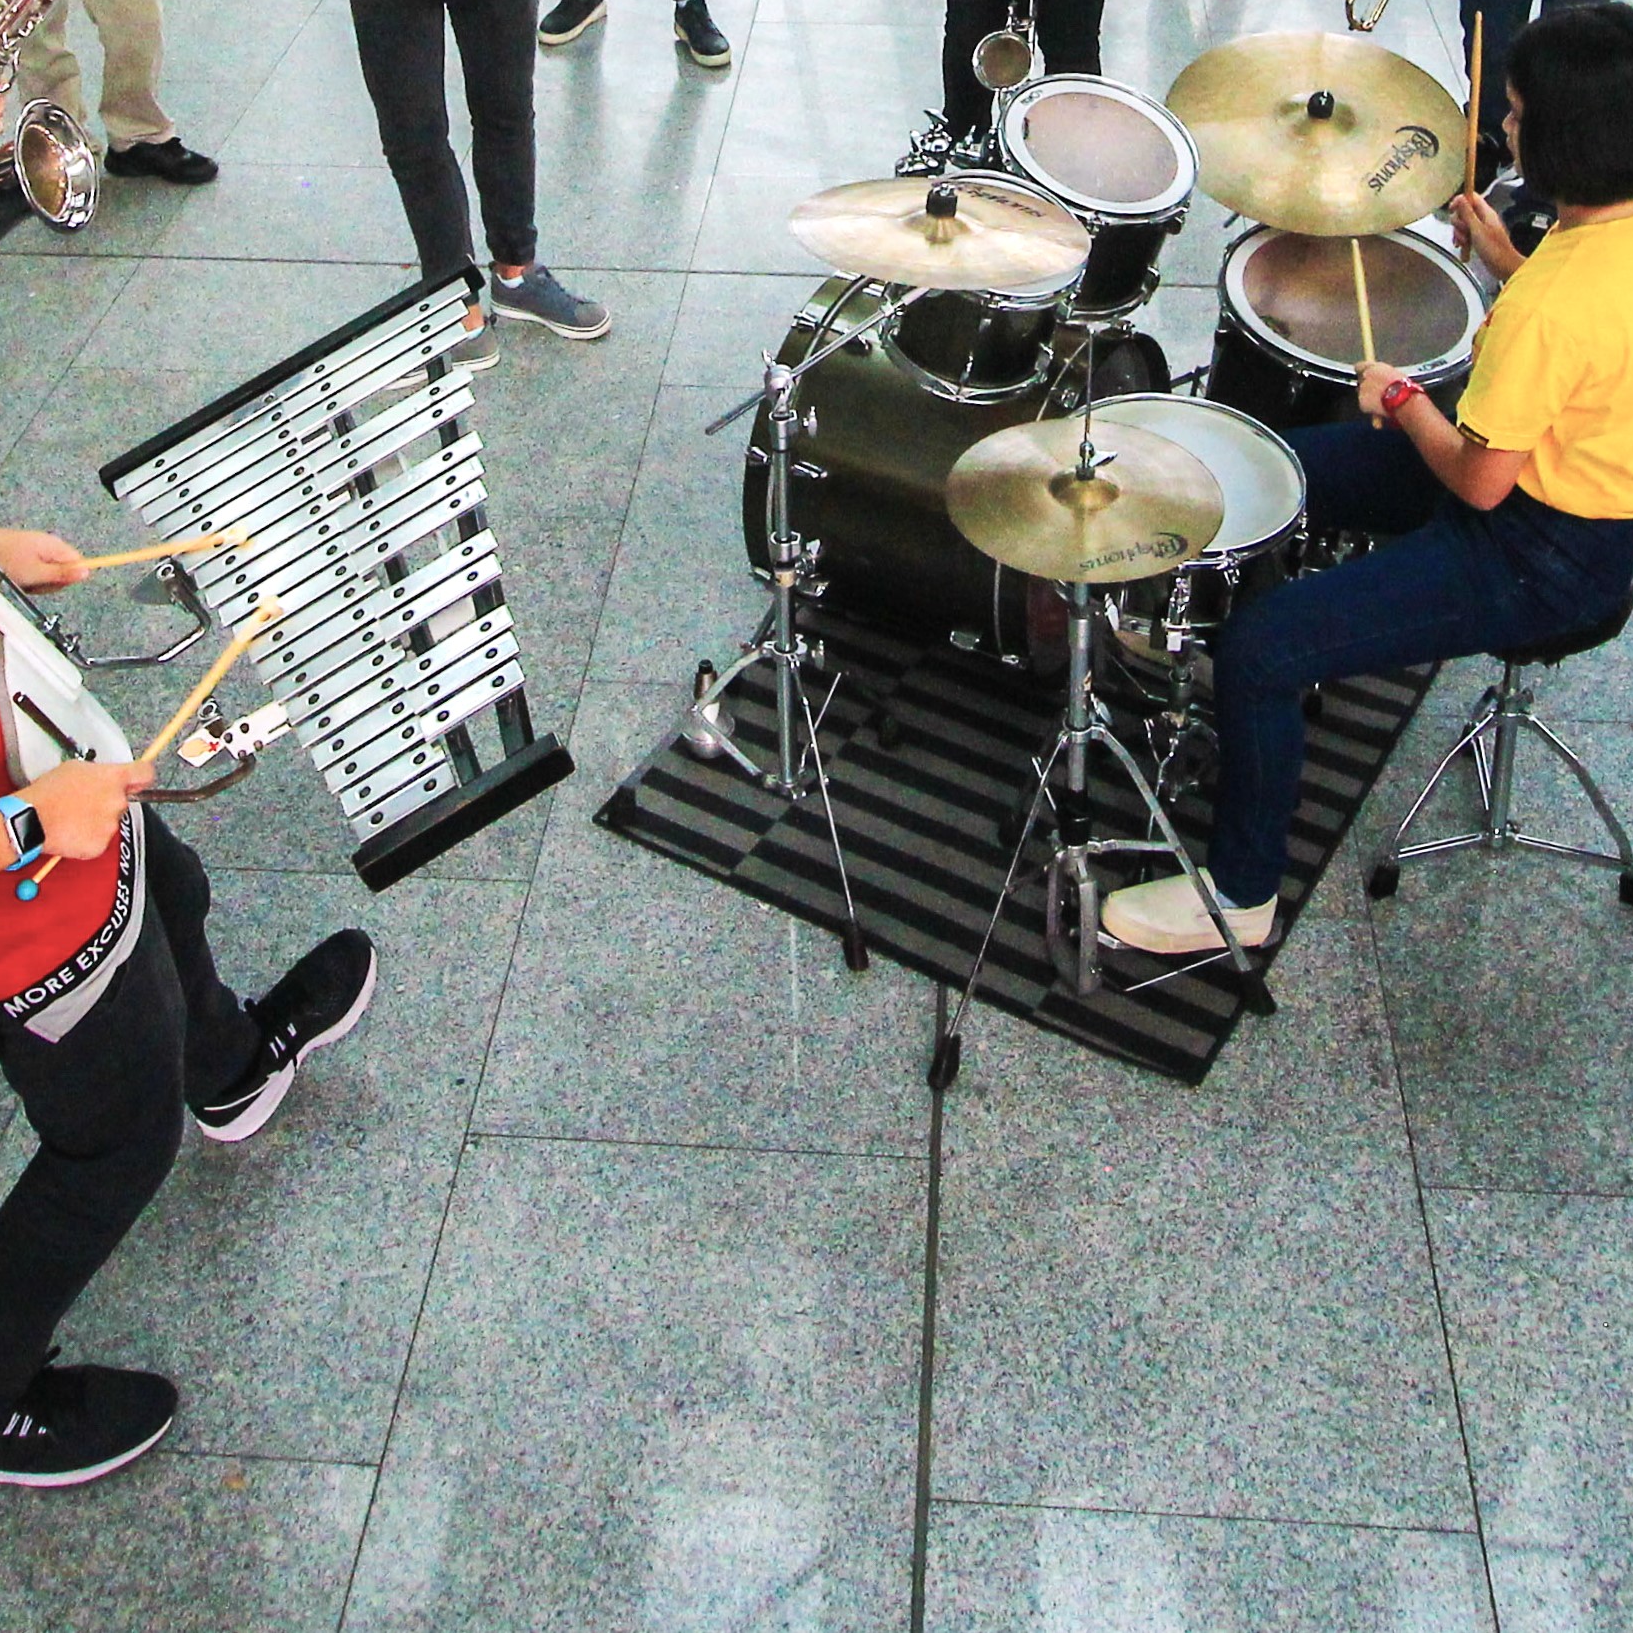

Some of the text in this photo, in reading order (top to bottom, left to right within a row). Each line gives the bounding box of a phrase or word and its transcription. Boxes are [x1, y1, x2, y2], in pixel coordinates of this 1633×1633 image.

[2, 966, 76, 1019] MORE
[75, 882, 131, 972] EXCUSES
[119, 844, 131, 877] NO
